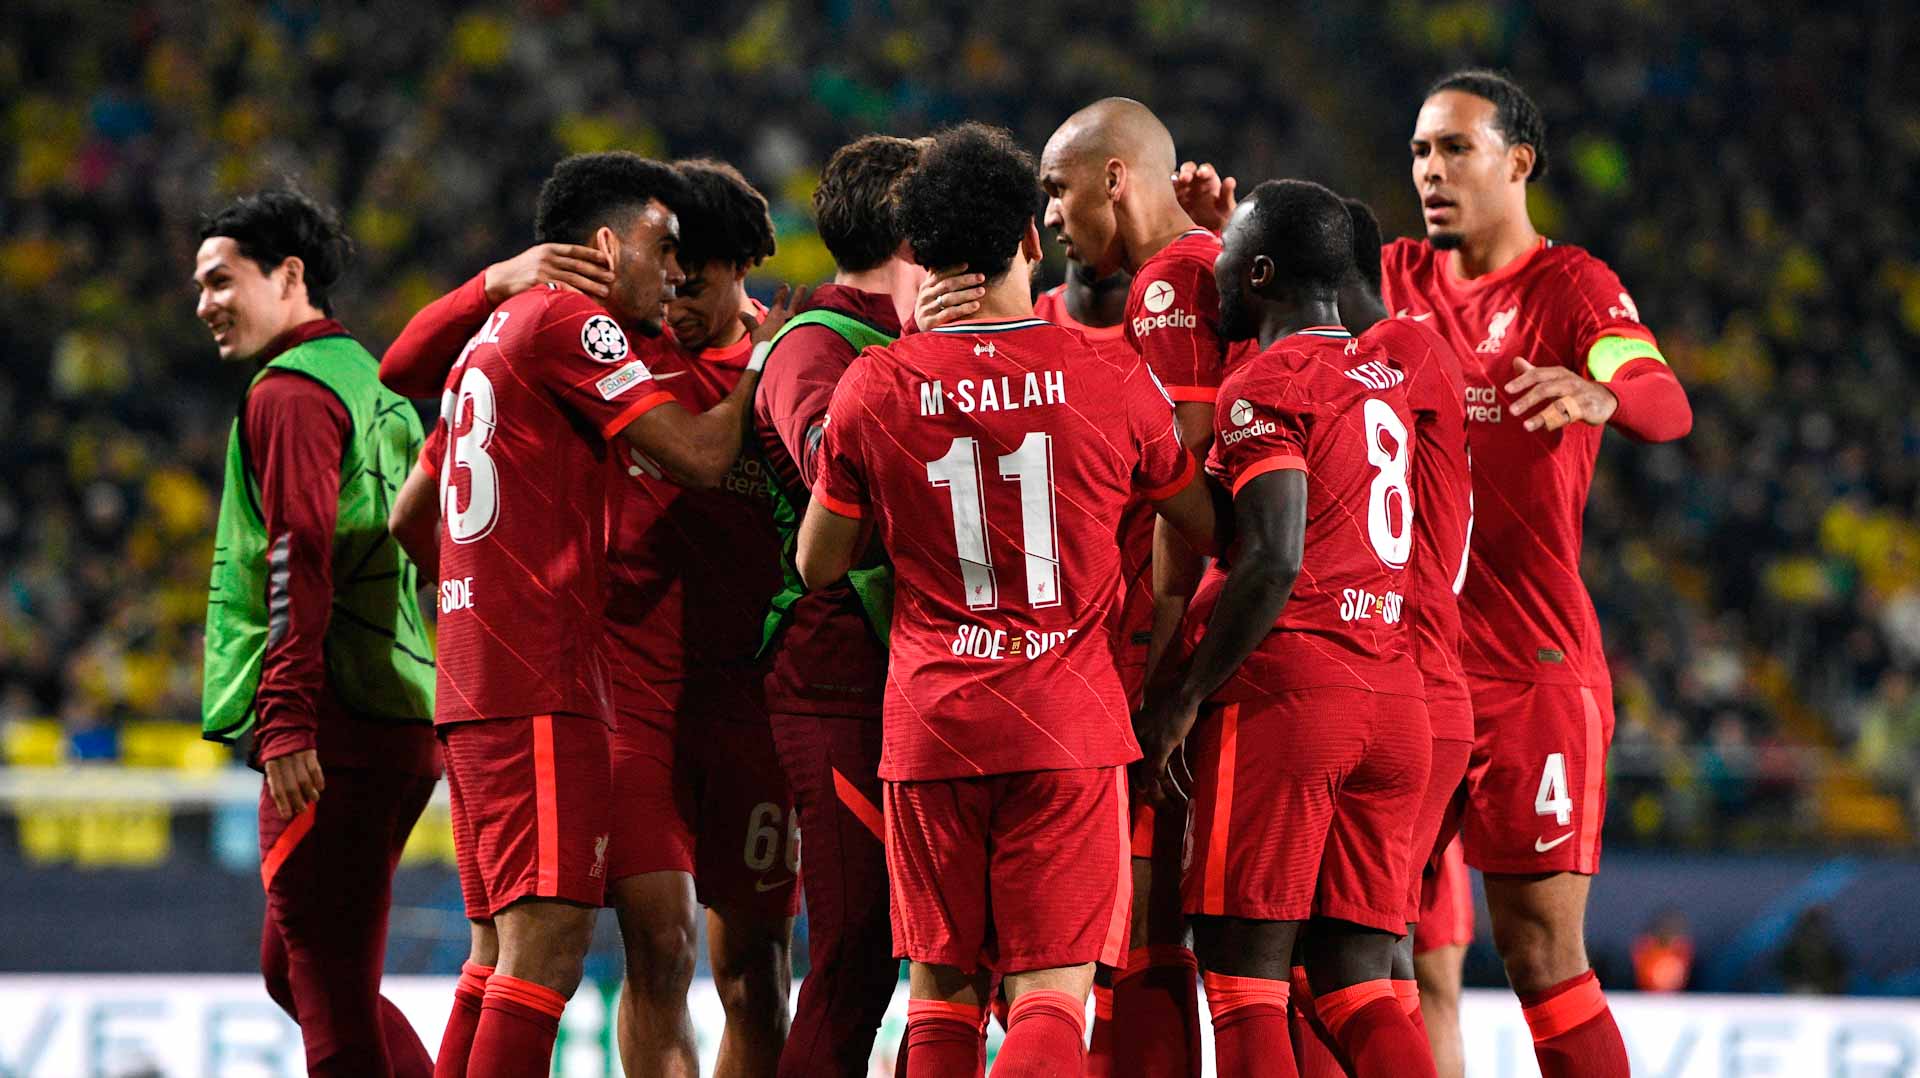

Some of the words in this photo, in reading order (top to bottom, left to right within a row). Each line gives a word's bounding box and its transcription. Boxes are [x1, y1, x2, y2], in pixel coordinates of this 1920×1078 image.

[1132, 308, 1196, 337] Expedia
[1221, 419, 1277, 446] Expedia
[1363, 398, 1414, 569] 8
[926, 431, 1062, 611] 11
[442, 577, 475, 614] SIDE
[951, 624, 1007, 660] SIDE
[1534, 752, 1573, 826] 4
